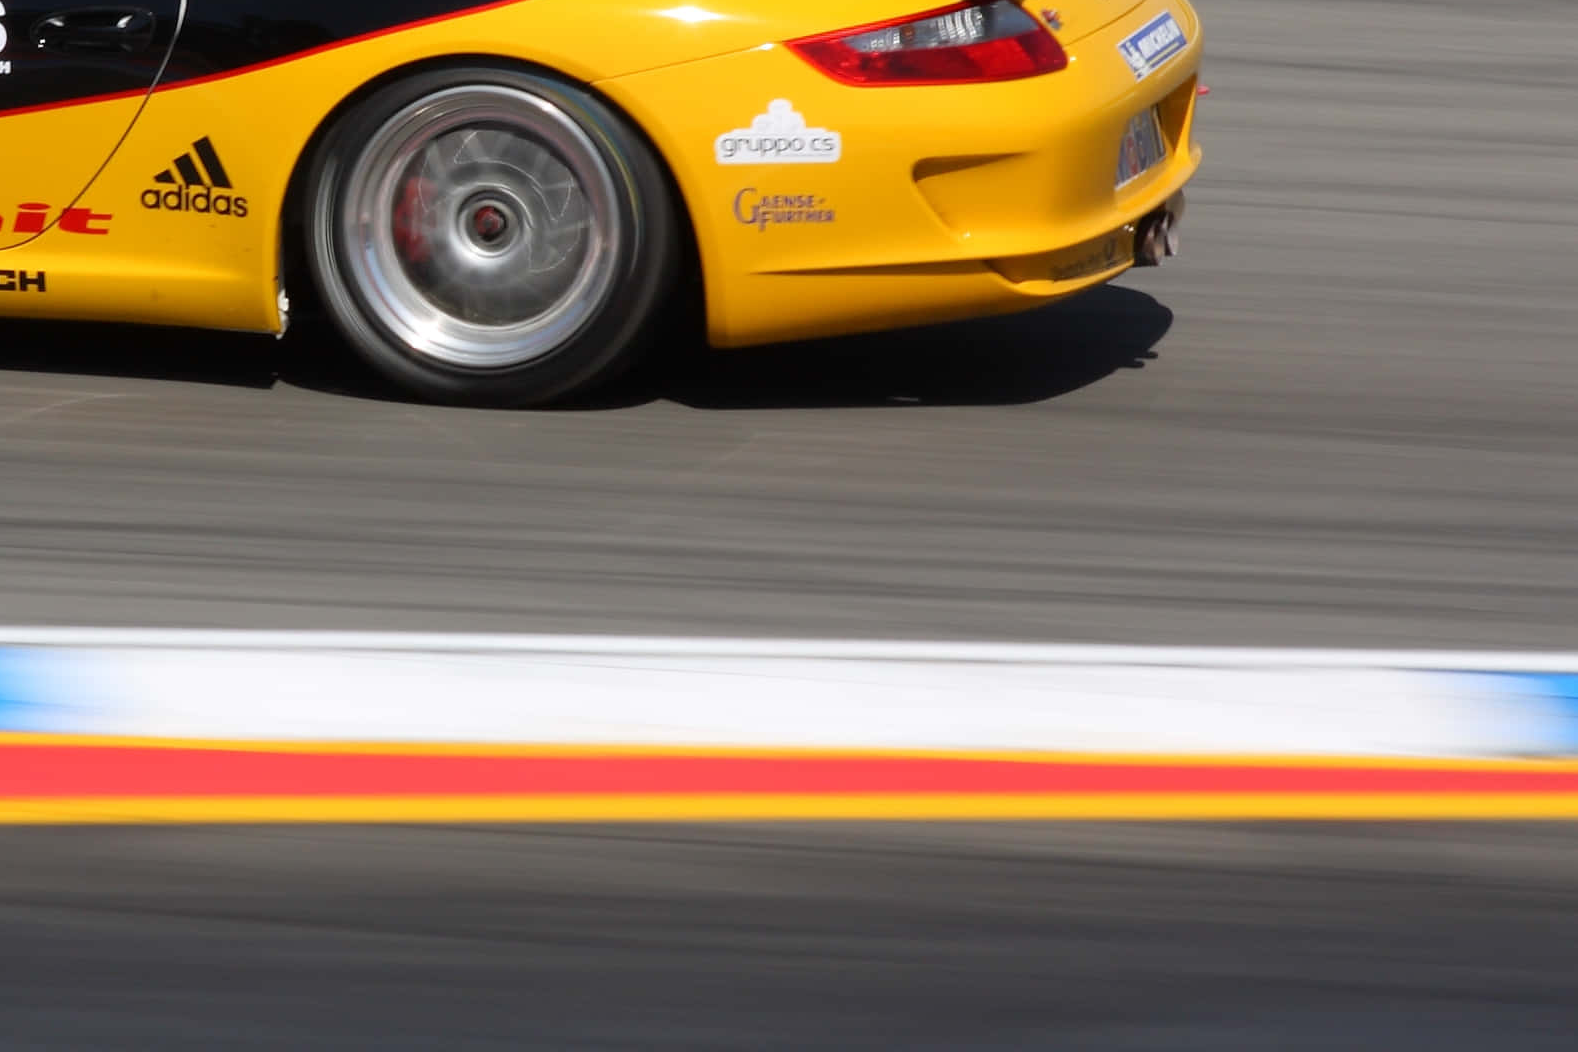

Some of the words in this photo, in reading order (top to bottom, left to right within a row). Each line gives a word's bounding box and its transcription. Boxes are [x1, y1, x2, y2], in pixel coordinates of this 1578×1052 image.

[721, 137, 805, 157] gruppo
[810, 137, 834, 152] cs
[140, 184, 249, 218] adidas
